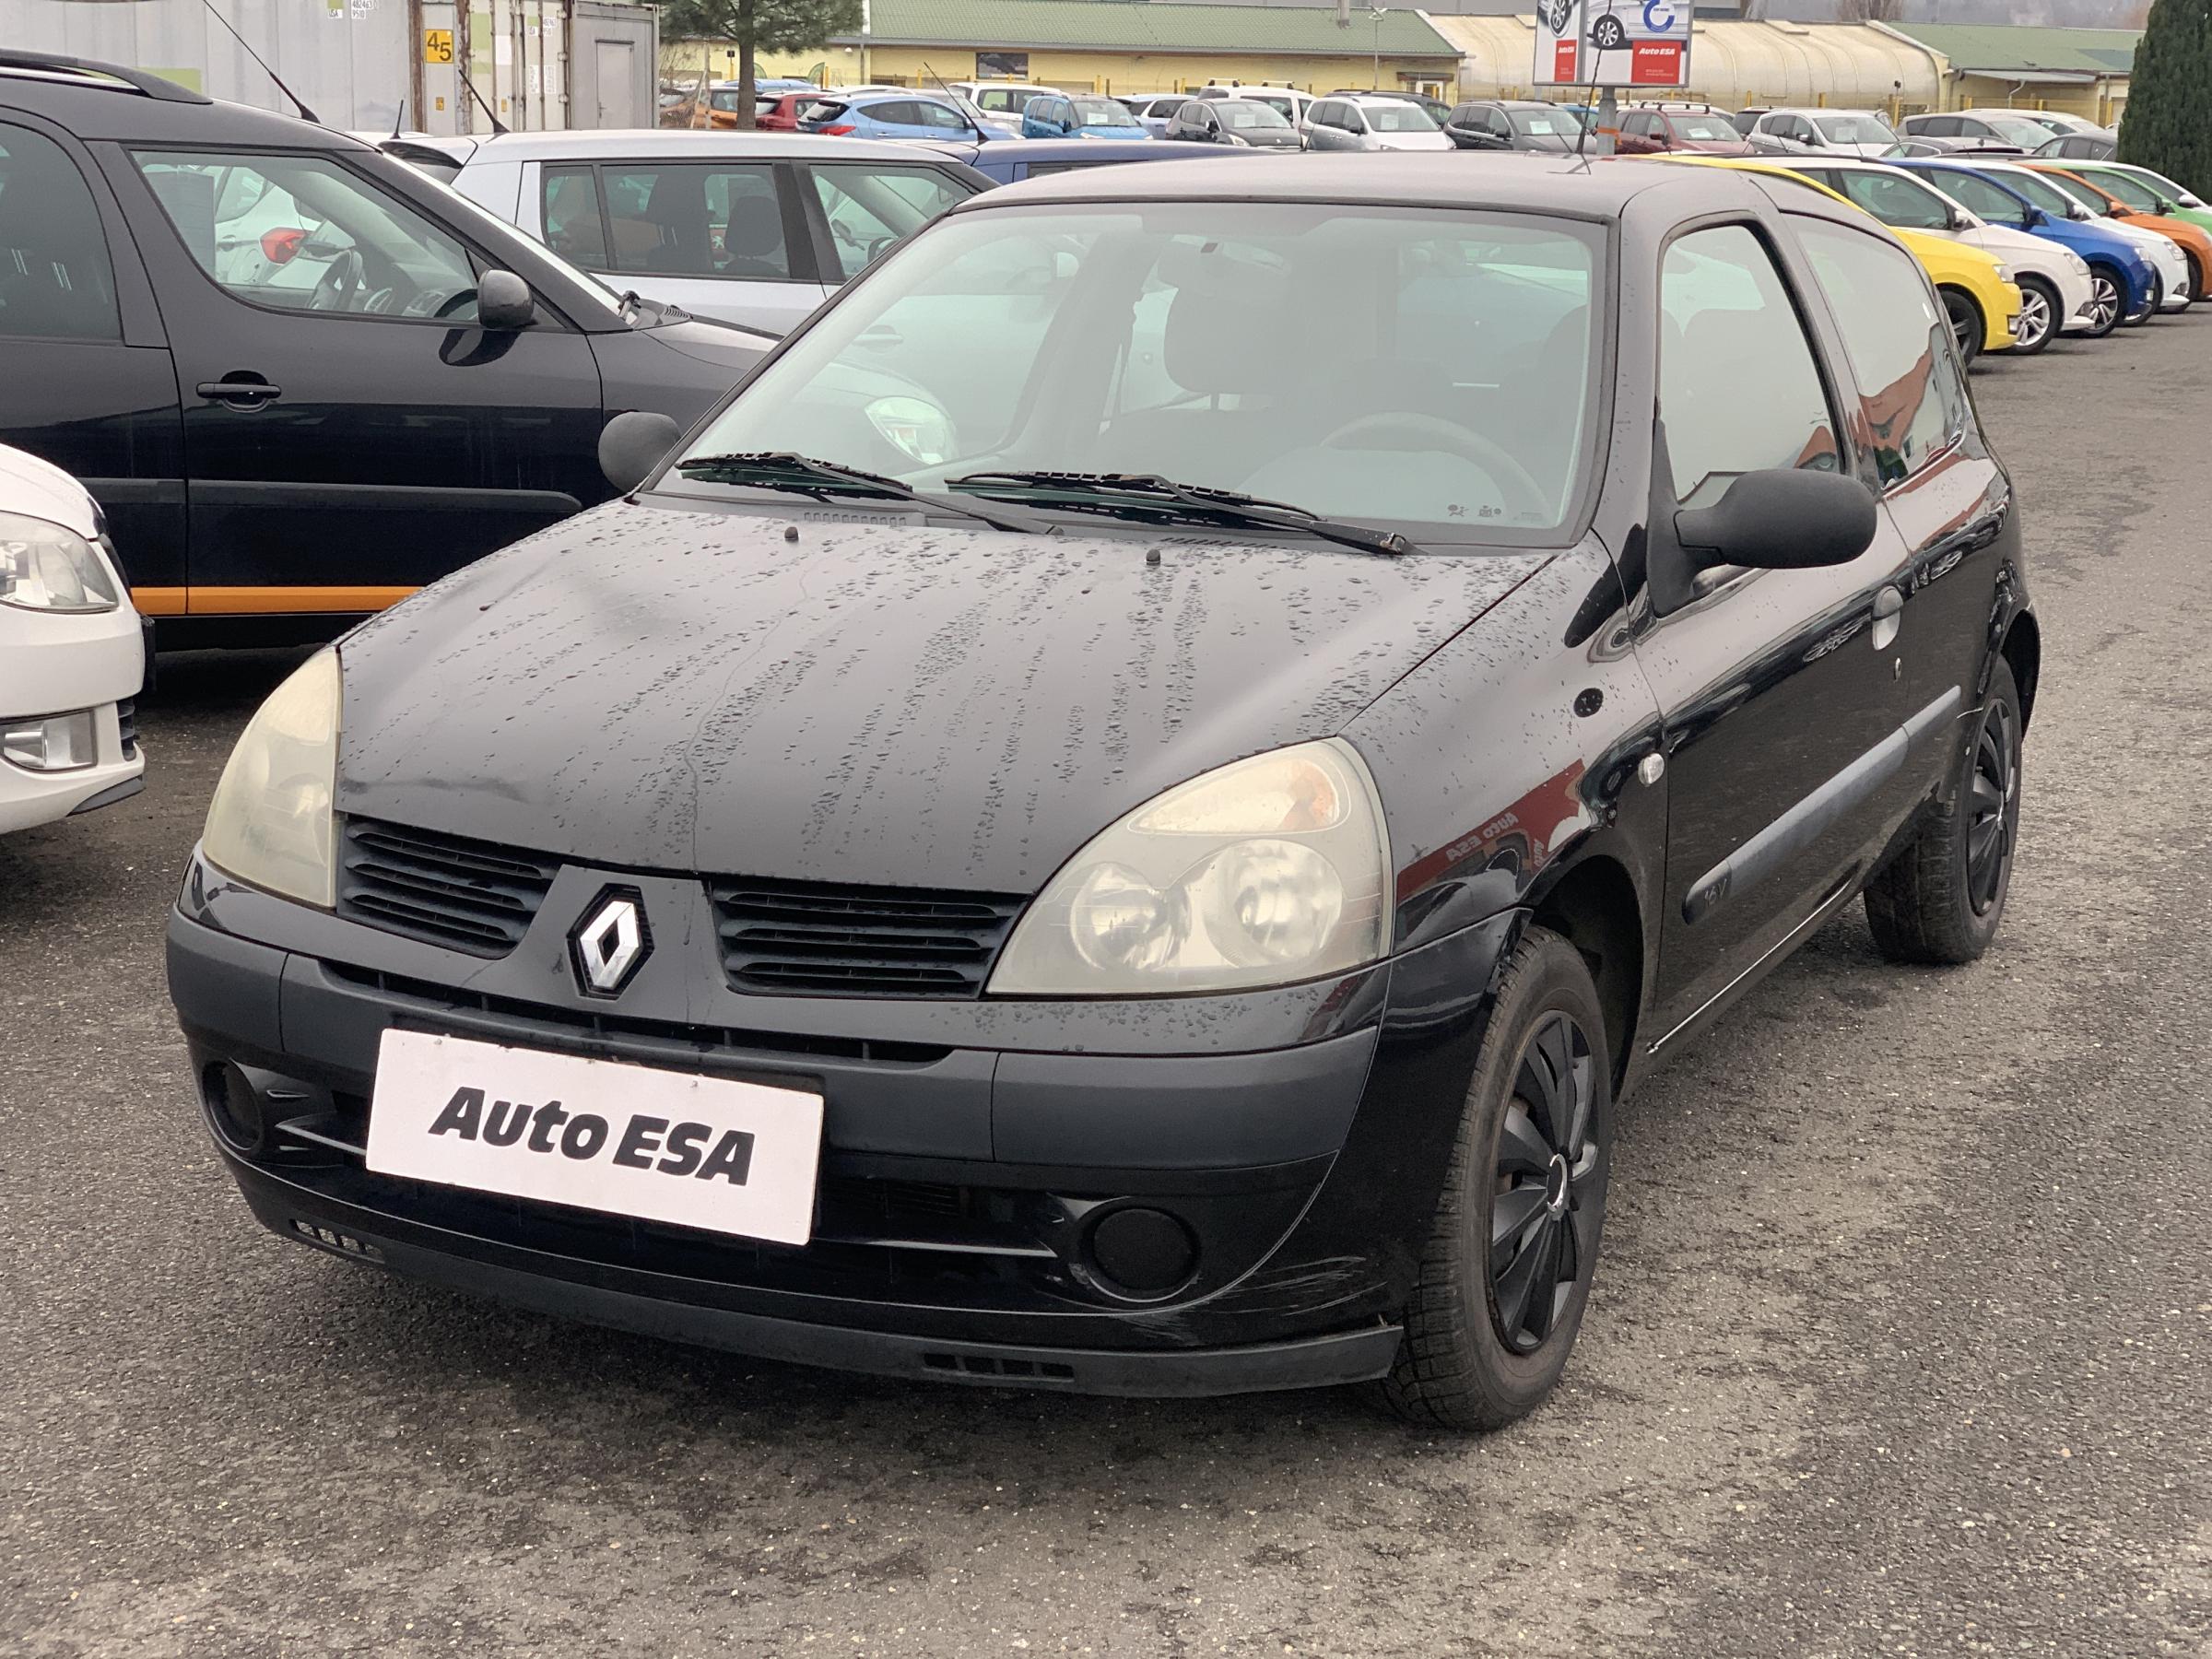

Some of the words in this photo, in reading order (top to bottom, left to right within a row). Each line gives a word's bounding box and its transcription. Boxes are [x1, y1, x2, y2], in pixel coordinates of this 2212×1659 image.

[427, 32, 452, 62] 45
[428, 1086, 609, 1160] Auto
[612, 1114, 756, 1187] ESA
